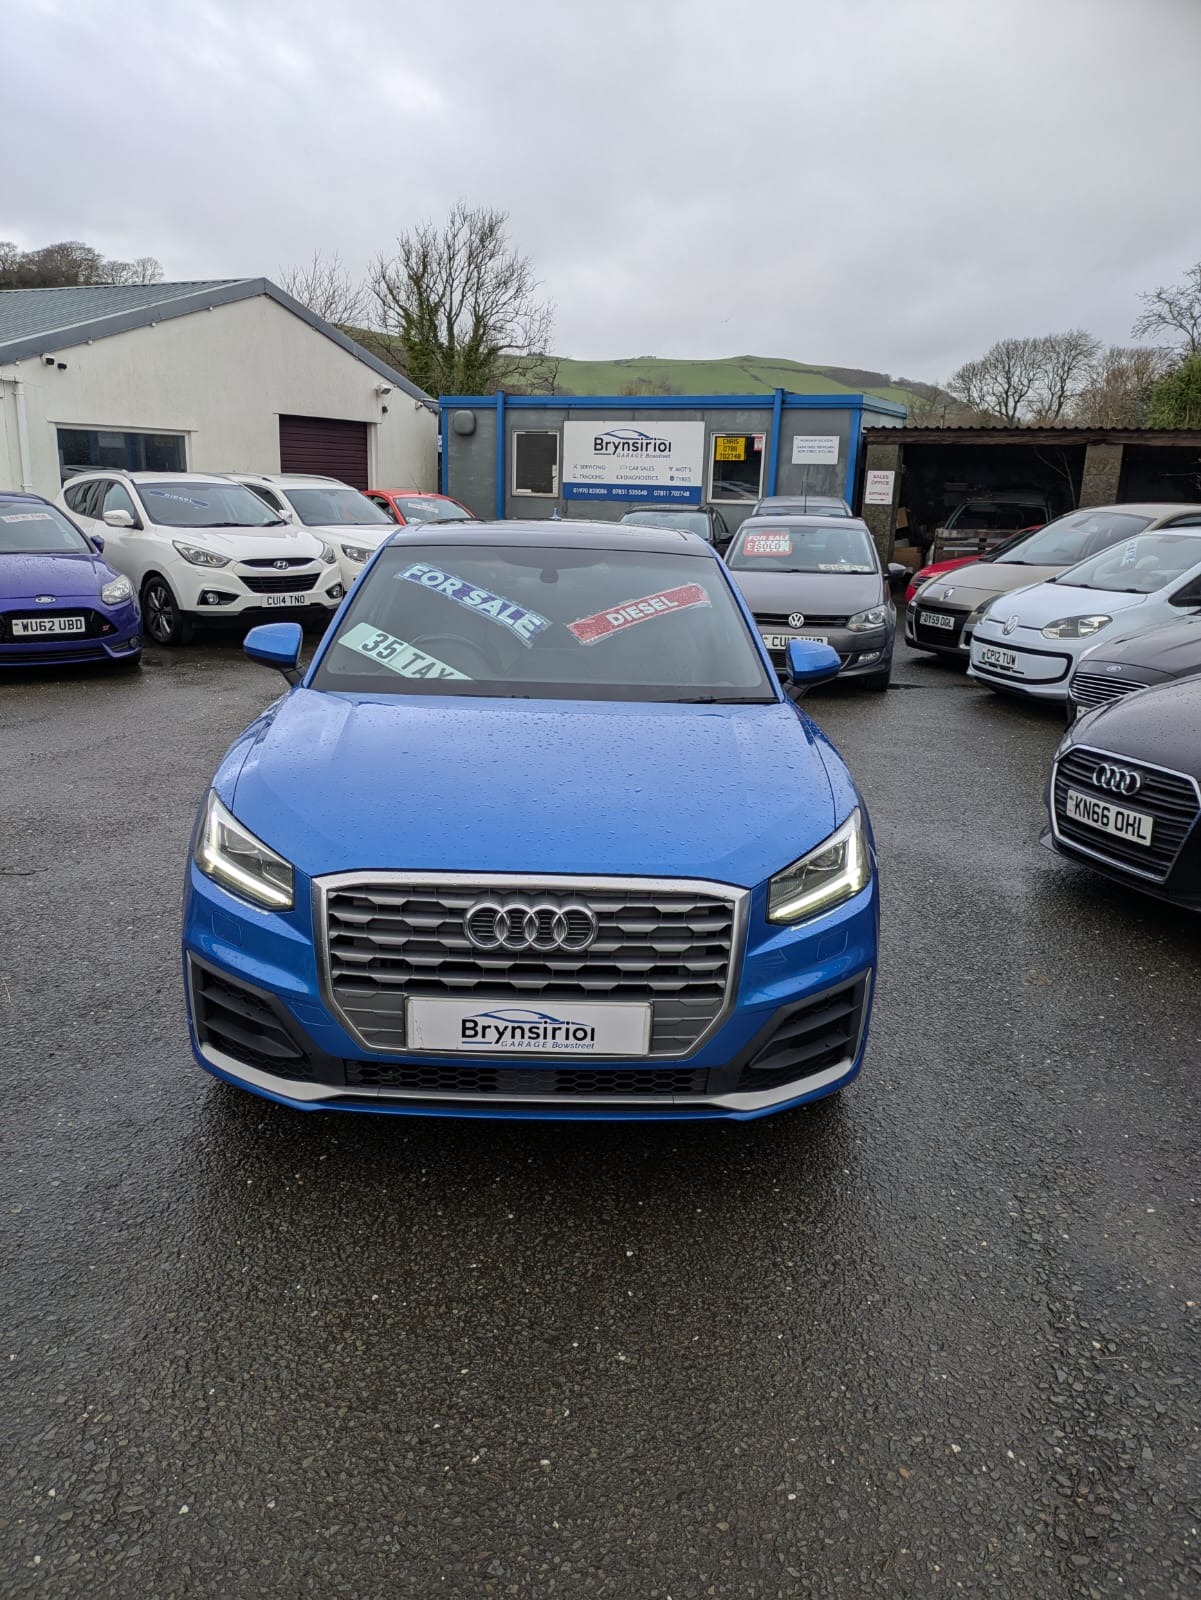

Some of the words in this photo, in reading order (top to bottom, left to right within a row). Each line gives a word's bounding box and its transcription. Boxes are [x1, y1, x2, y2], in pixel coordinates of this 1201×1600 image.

[593, 437, 672, 455] Brynsiriol
[755, 542, 781, 550] SOLD
[267, 596, 286, 606] CU14
[402, 565, 462, 596] FOR
[462, 586, 542, 640] SALE
[606, 596, 679, 627] DIESEL
[21, 620, 56, 632] WU62
[58, 618, 82, 630] UBD
[361, 633, 404, 660] 35
[986, 648, 1001, 663] CP12
[1002, 652, 1016, 666] TUW
[1074, 796, 1110, 827] KN66
[1114, 810, 1147, 840] OHL
[461, 1018, 596, 1044] Brynsiriol
[501, 1040, 549, 1048] GARAGE
[551, 1041, 596, 1050] Bowstreet
